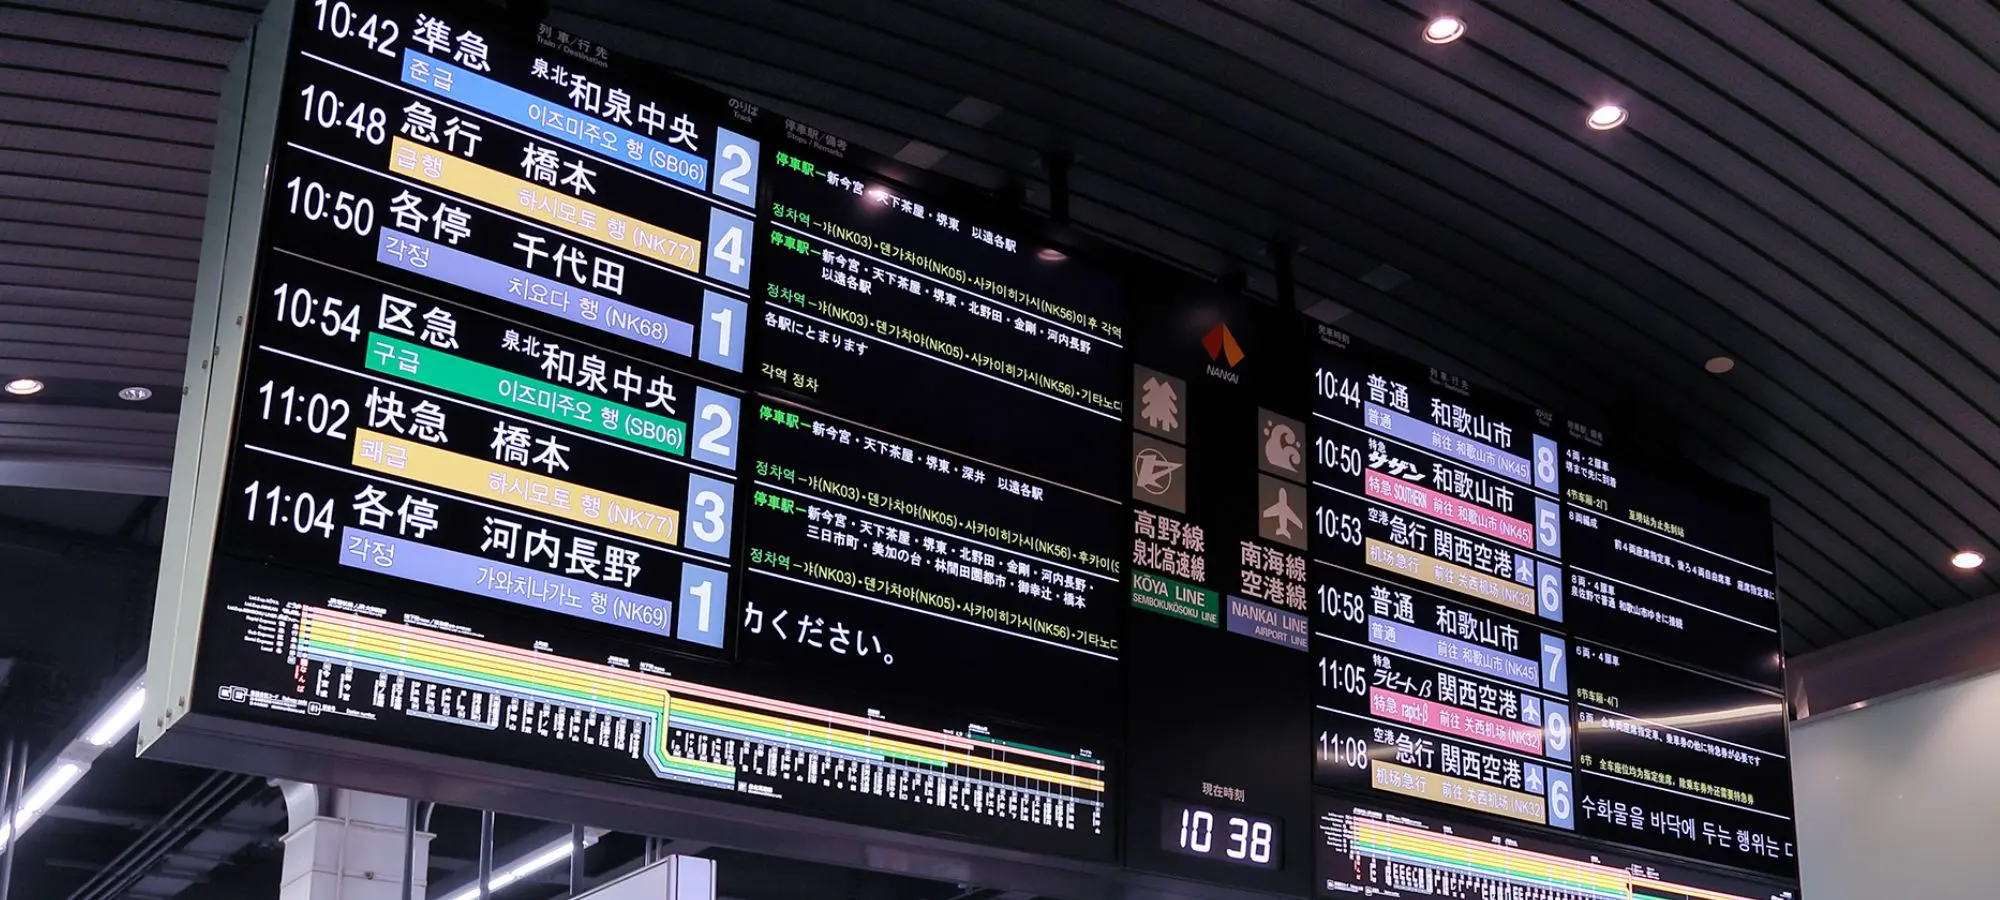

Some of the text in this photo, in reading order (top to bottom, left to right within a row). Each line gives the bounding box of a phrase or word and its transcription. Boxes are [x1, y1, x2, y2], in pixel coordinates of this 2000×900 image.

[314, 0, 399, 58] 10:42
[411, 12, 492, 74] 準急
[720, 143, 751, 197] 2
[407, 57, 706, 186] 준급 이즈미주오 행 (SB06)
[300, 84, 746, 275] 10:48 急行 橋本 4
[394, 144, 697, 267] 급행 하시모토 행 (NK77)
[286, 177, 731, 358] 10:50 各停 千代田 1
[384, 234, 670, 346] 각정 치요다 행 (NK68)
[272, 284, 362, 344] 10:54
[378, 294, 460, 352] 区急
[698, 402, 733, 457] 2
[763, 311, 870, 357] 各駅にとまります
[372, 340, 683, 452] 구급 이즈미주오 행 (SB06)
[1206, 364, 1240, 385] NANKAI
[258, 380, 726, 542] 11:02 快急 橋本 3
[1315, 368, 1361, 408] 10:44
[1367, 373, 1411, 413] 普通
[1431, 397, 1513, 449] 和歌山市
[1537, 446, 1556, 483] 8
[1368, 408, 1531, 481] 普通 前往 和歌山市 (NK45)
[359, 437, 675, 541] 쾌급 하시모토 행 (NK77)
[1315, 436, 1557, 547] 10:50 サザン 和歌山市 5
[1368, 475, 1392, 498] 特急
[1433, 497, 1455, 519] 前往
[1458, 505, 1498, 532] 和歌山市
[1499, 519, 1533, 548] (NK45)
[244, 480, 713, 632] 11:04 各停 河内長野 1
[1132, 537, 1206, 583] 泉北高速線
[1133, 508, 1205, 553] 高野線
[1239, 541, 1307, 583] 南海線
[1315, 506, 1362, 546] 10:53
[1433, 528, 1513, 579] 関西空港
[1541, 574, 1560, 613] 6
[347, 536, 671, 635] 각정 가와치나가노 행 (NK69)
[1174, 583, 1206, 608] LINE
[1240, 569, 1308, 612] 空港線
[1433, 564, 1455, 584] 前往
[1200, 610, 1217, 625] LINE
[1231, 600, 1308, 635] NANKAI LINE
[1254, 625, 1308, 649] AIRPORT LINE
[1317, 584, 1563, 684] 10:58 普通 和歌山市 7
[1371, 622, 1539, 686] 普通 前往 和歌山市 (NK45)
[1318, 656, 1366, 696] 11:05
[1437, 672, 1518, 720] 関西空港
[1547, 712, 1567, 751] 9
[1373, 694, 1398, 716] 特急
[1439, 710, 1461, 730] 前往
[1508, 725, 1542, 752] (NK32)
[1202, 782, 1246, 803] 現在時刻
[1319, 730, 1368, 770] 11:08
[1441, 743, 1522, 790] 関西空港
[1550, 779, 1570, 820] 6
[1375, 767, 1428, 793] 机场急行
[1442, 780, 1464, 802] 前往
[1511, 797, 1544, 820] (NK32)
[1180, 808, 1214, 853] 10
[1226, 817, 1273, 864] 38
[1581, 794, 1780, 859] 수화물을 바닥에 두는 행위는
